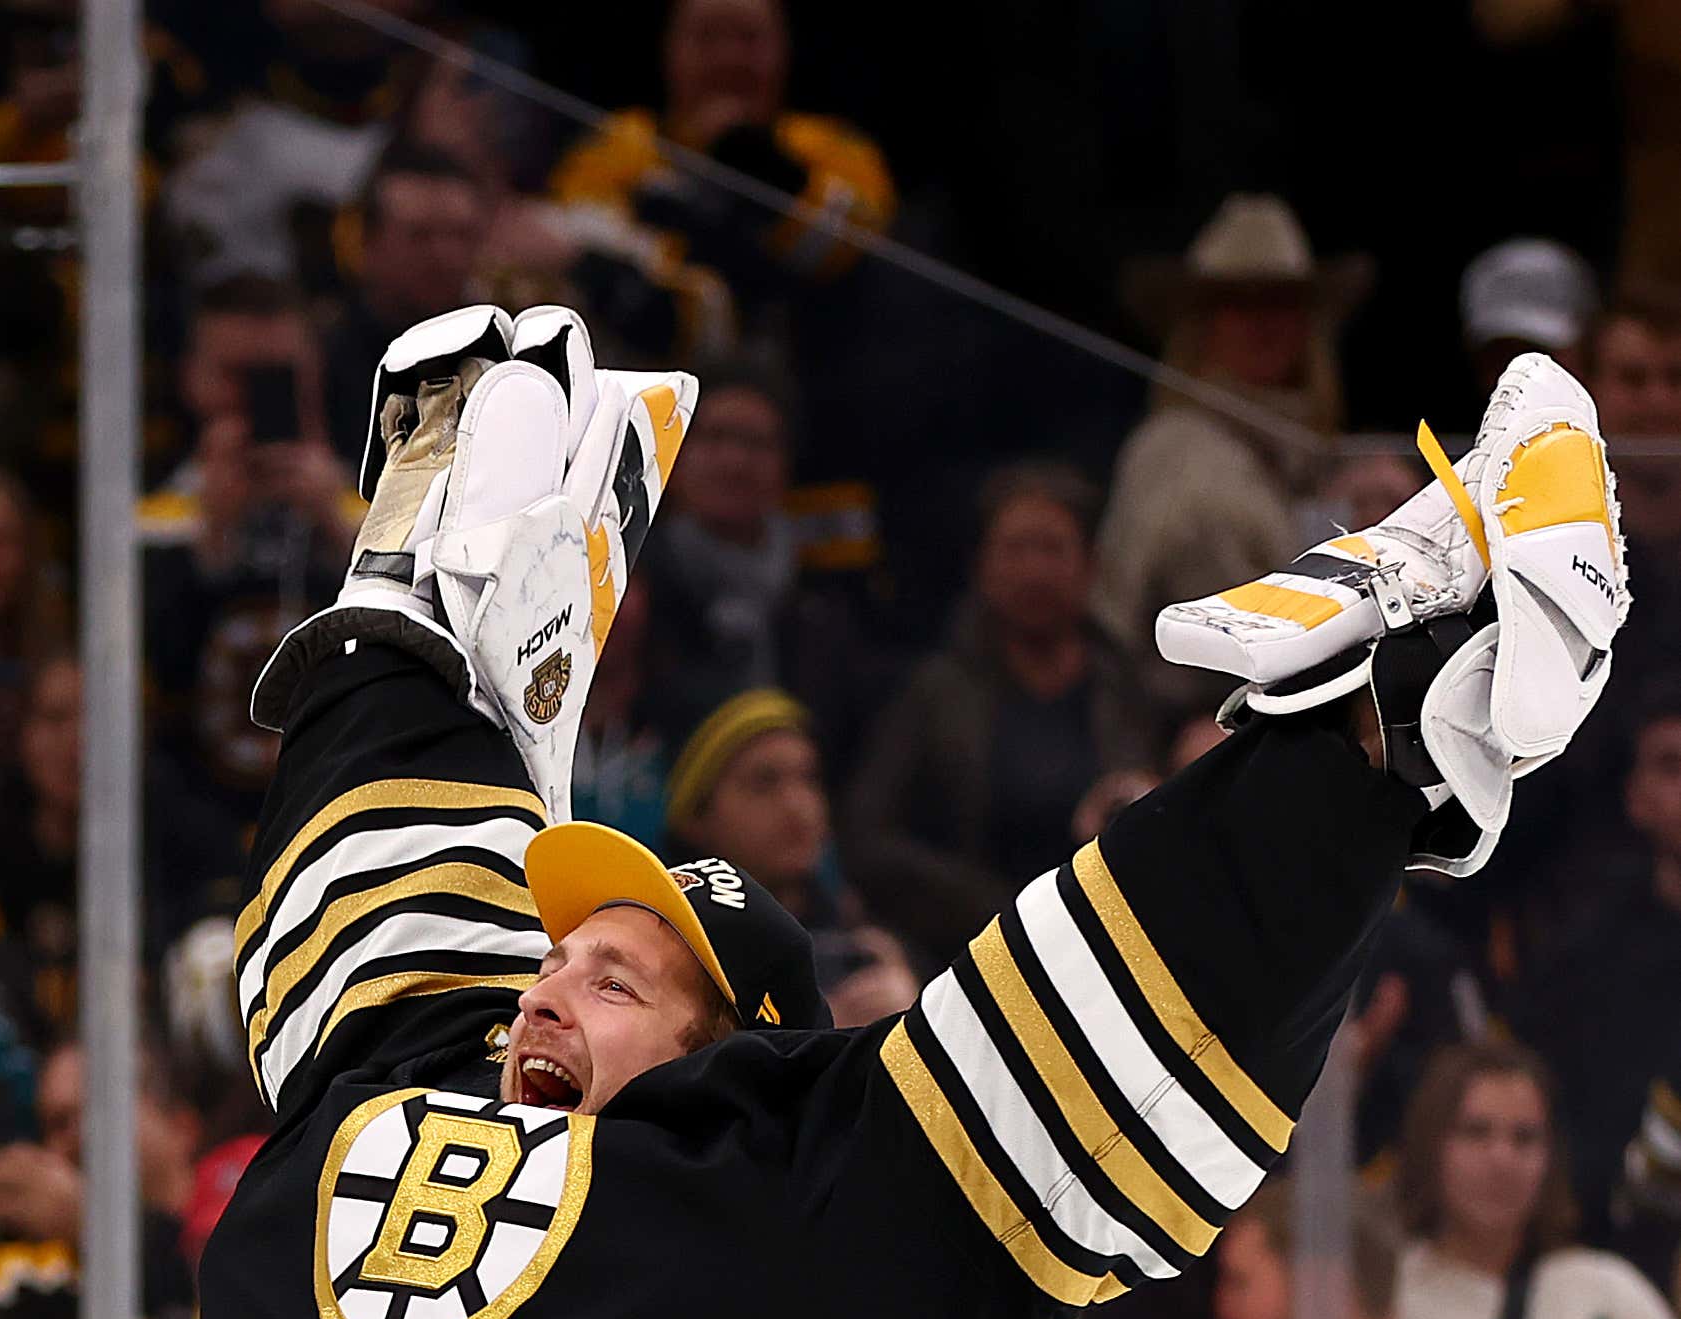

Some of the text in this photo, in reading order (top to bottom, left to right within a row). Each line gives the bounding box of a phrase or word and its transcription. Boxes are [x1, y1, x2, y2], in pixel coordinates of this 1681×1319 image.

[1572, 554, 1615, 606] MACH
[517, 603, 573, 666] MACH
[358, 1111, 523, 1289] B
